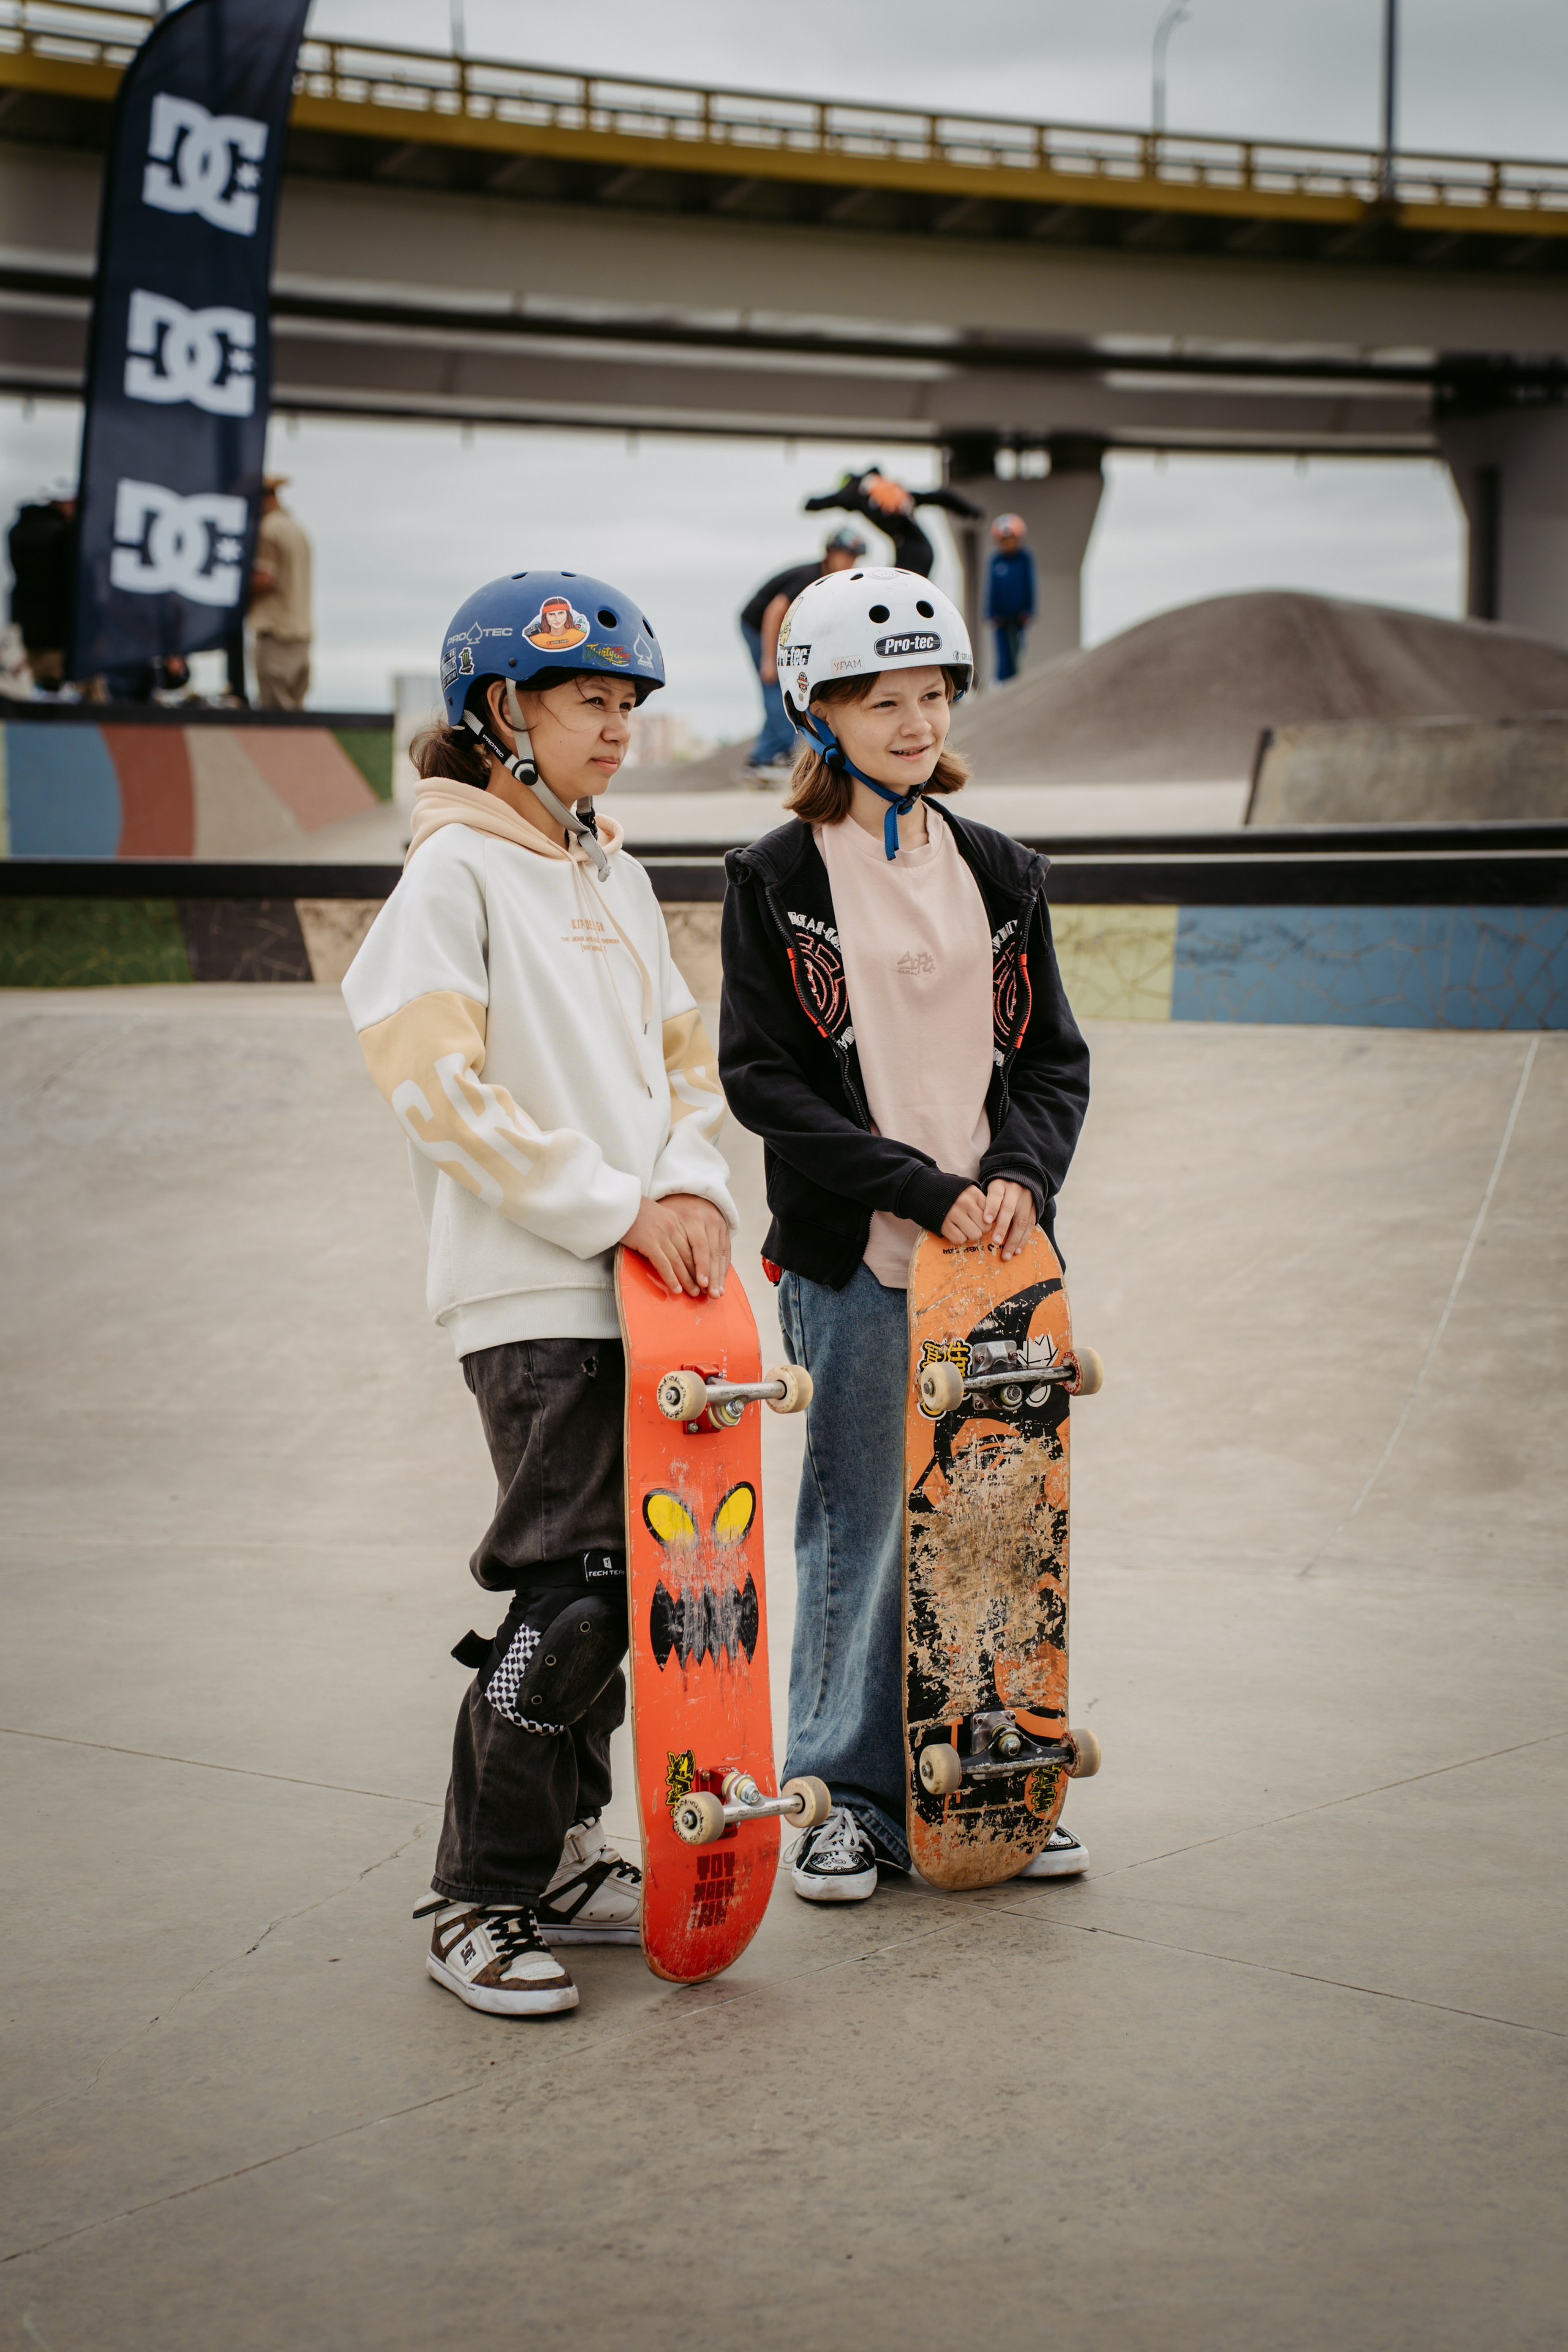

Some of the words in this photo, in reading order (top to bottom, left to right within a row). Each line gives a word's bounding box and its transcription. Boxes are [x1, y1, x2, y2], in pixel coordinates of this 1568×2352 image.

[142, 92, 269, 237] DC
[124, 287, 256, 418] DC
[110, 477, 247, 608] DC
[447, 632, 467, 646] PRO
[483, 628, 513, 637] TEC
[884, 636, 934, 654] Pro-tec
[697, 1851, 735, 1881] TOY
[460, 1939, 477, 1967] DC
